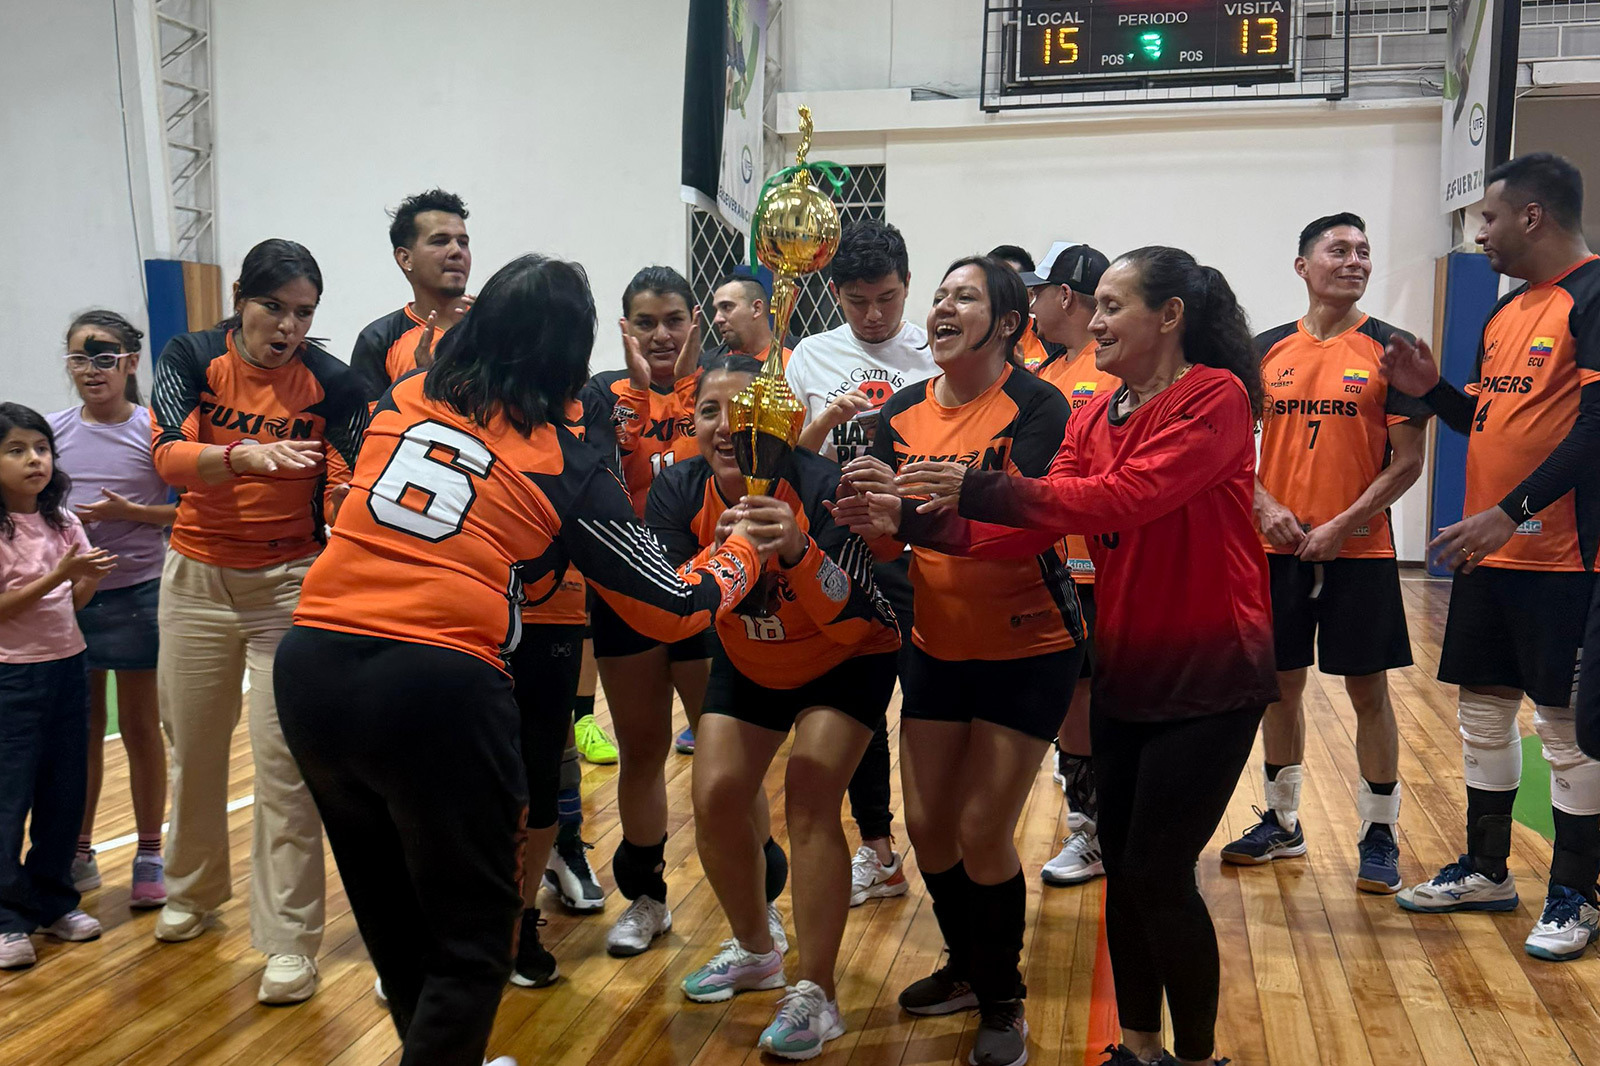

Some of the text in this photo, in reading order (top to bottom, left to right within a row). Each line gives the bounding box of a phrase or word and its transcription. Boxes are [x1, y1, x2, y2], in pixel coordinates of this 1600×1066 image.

[1224, 1, 1283, 15] VISITA
[1026, 12, 1085, 26] LOCAL
[1118, 12, 1188, 26] PERIODO
[1242, 18, 1278, 54] 13
[1043, 27, 1079, 64] 15
[1101, 54, 1125, 66] POS
[1180, 50, 1203, 62] POS
[1527, 357, 1545, 367] ECU
[825, 367, 905, 408] The Gym is
[1344, 384, 1362, 394] ECU
[1275, 399, 1358, 417] SPIKERS
[1475, 399, 1493, 432] 4
[1307, 420, 1321, 450] 7
[366, 418, 496, 543] 6
[739, 614, 786, 641] 18
